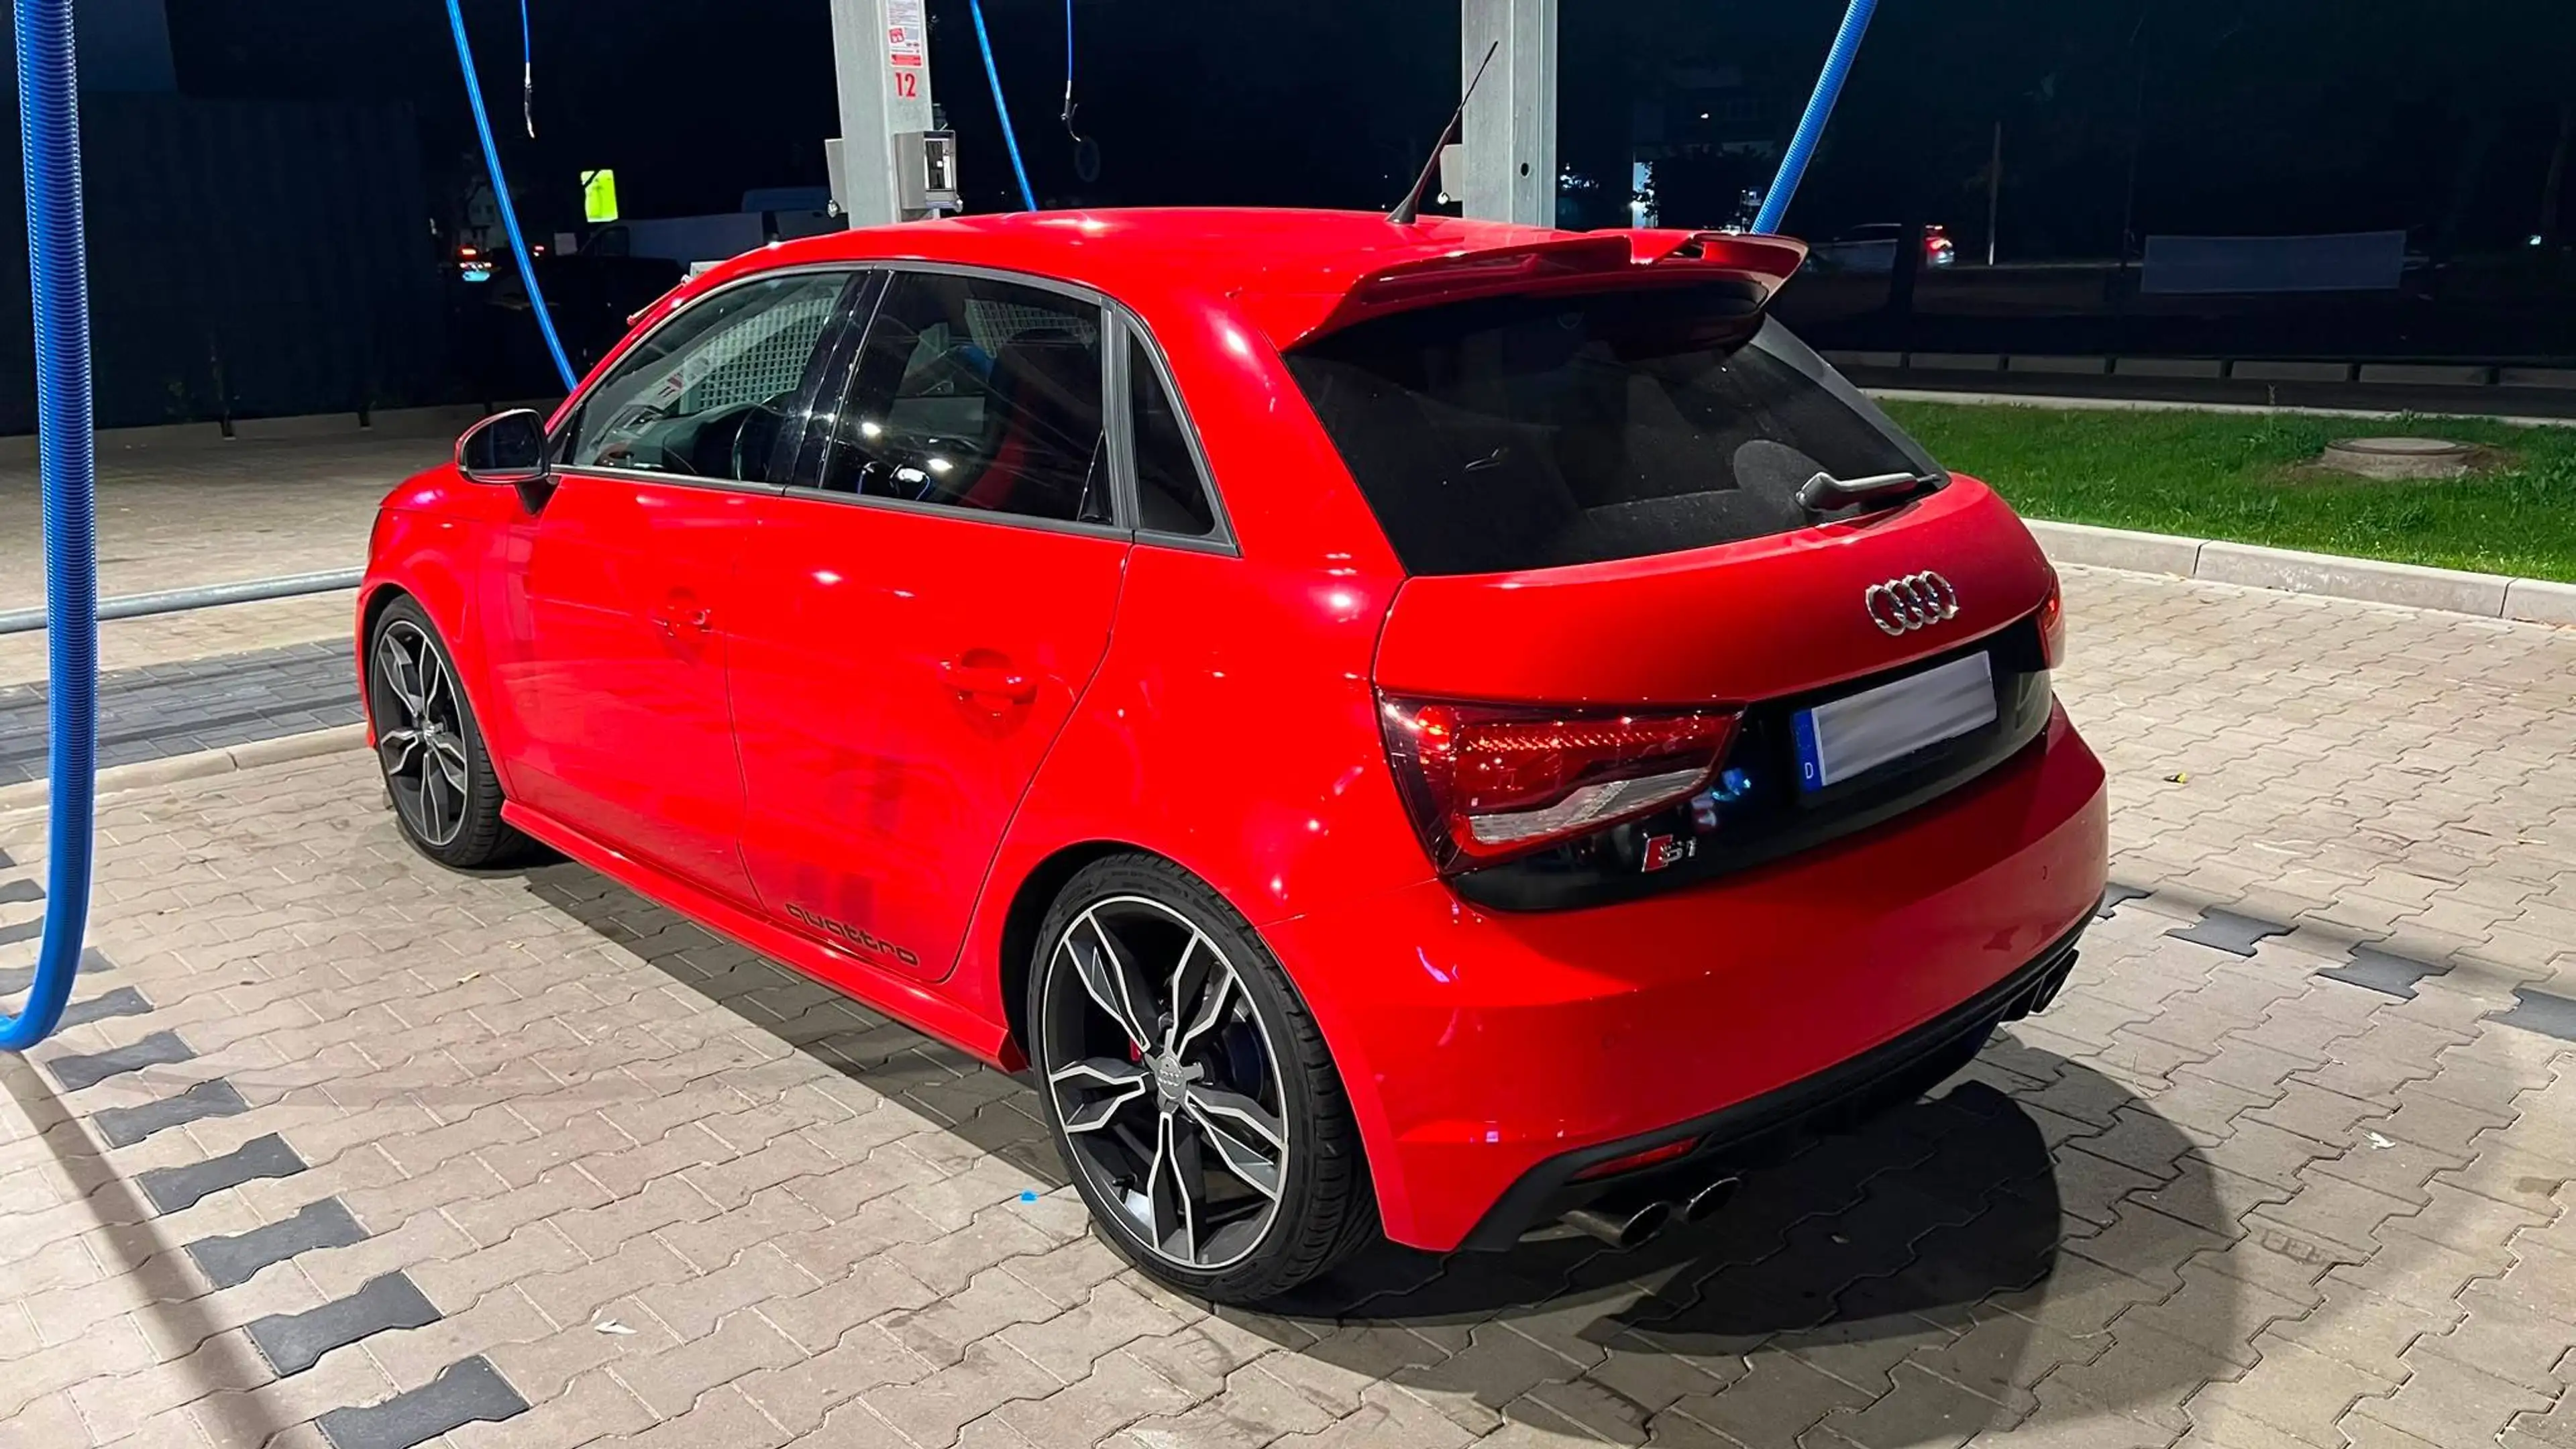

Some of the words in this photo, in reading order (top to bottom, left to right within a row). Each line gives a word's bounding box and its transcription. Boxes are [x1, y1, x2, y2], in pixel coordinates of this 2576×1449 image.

[895, 72, 916, 97] 12
[1805, 762, 1814, 780] D
[1660, 837, 1697, 864] S1
[785, 904, 919, 966] quattro
